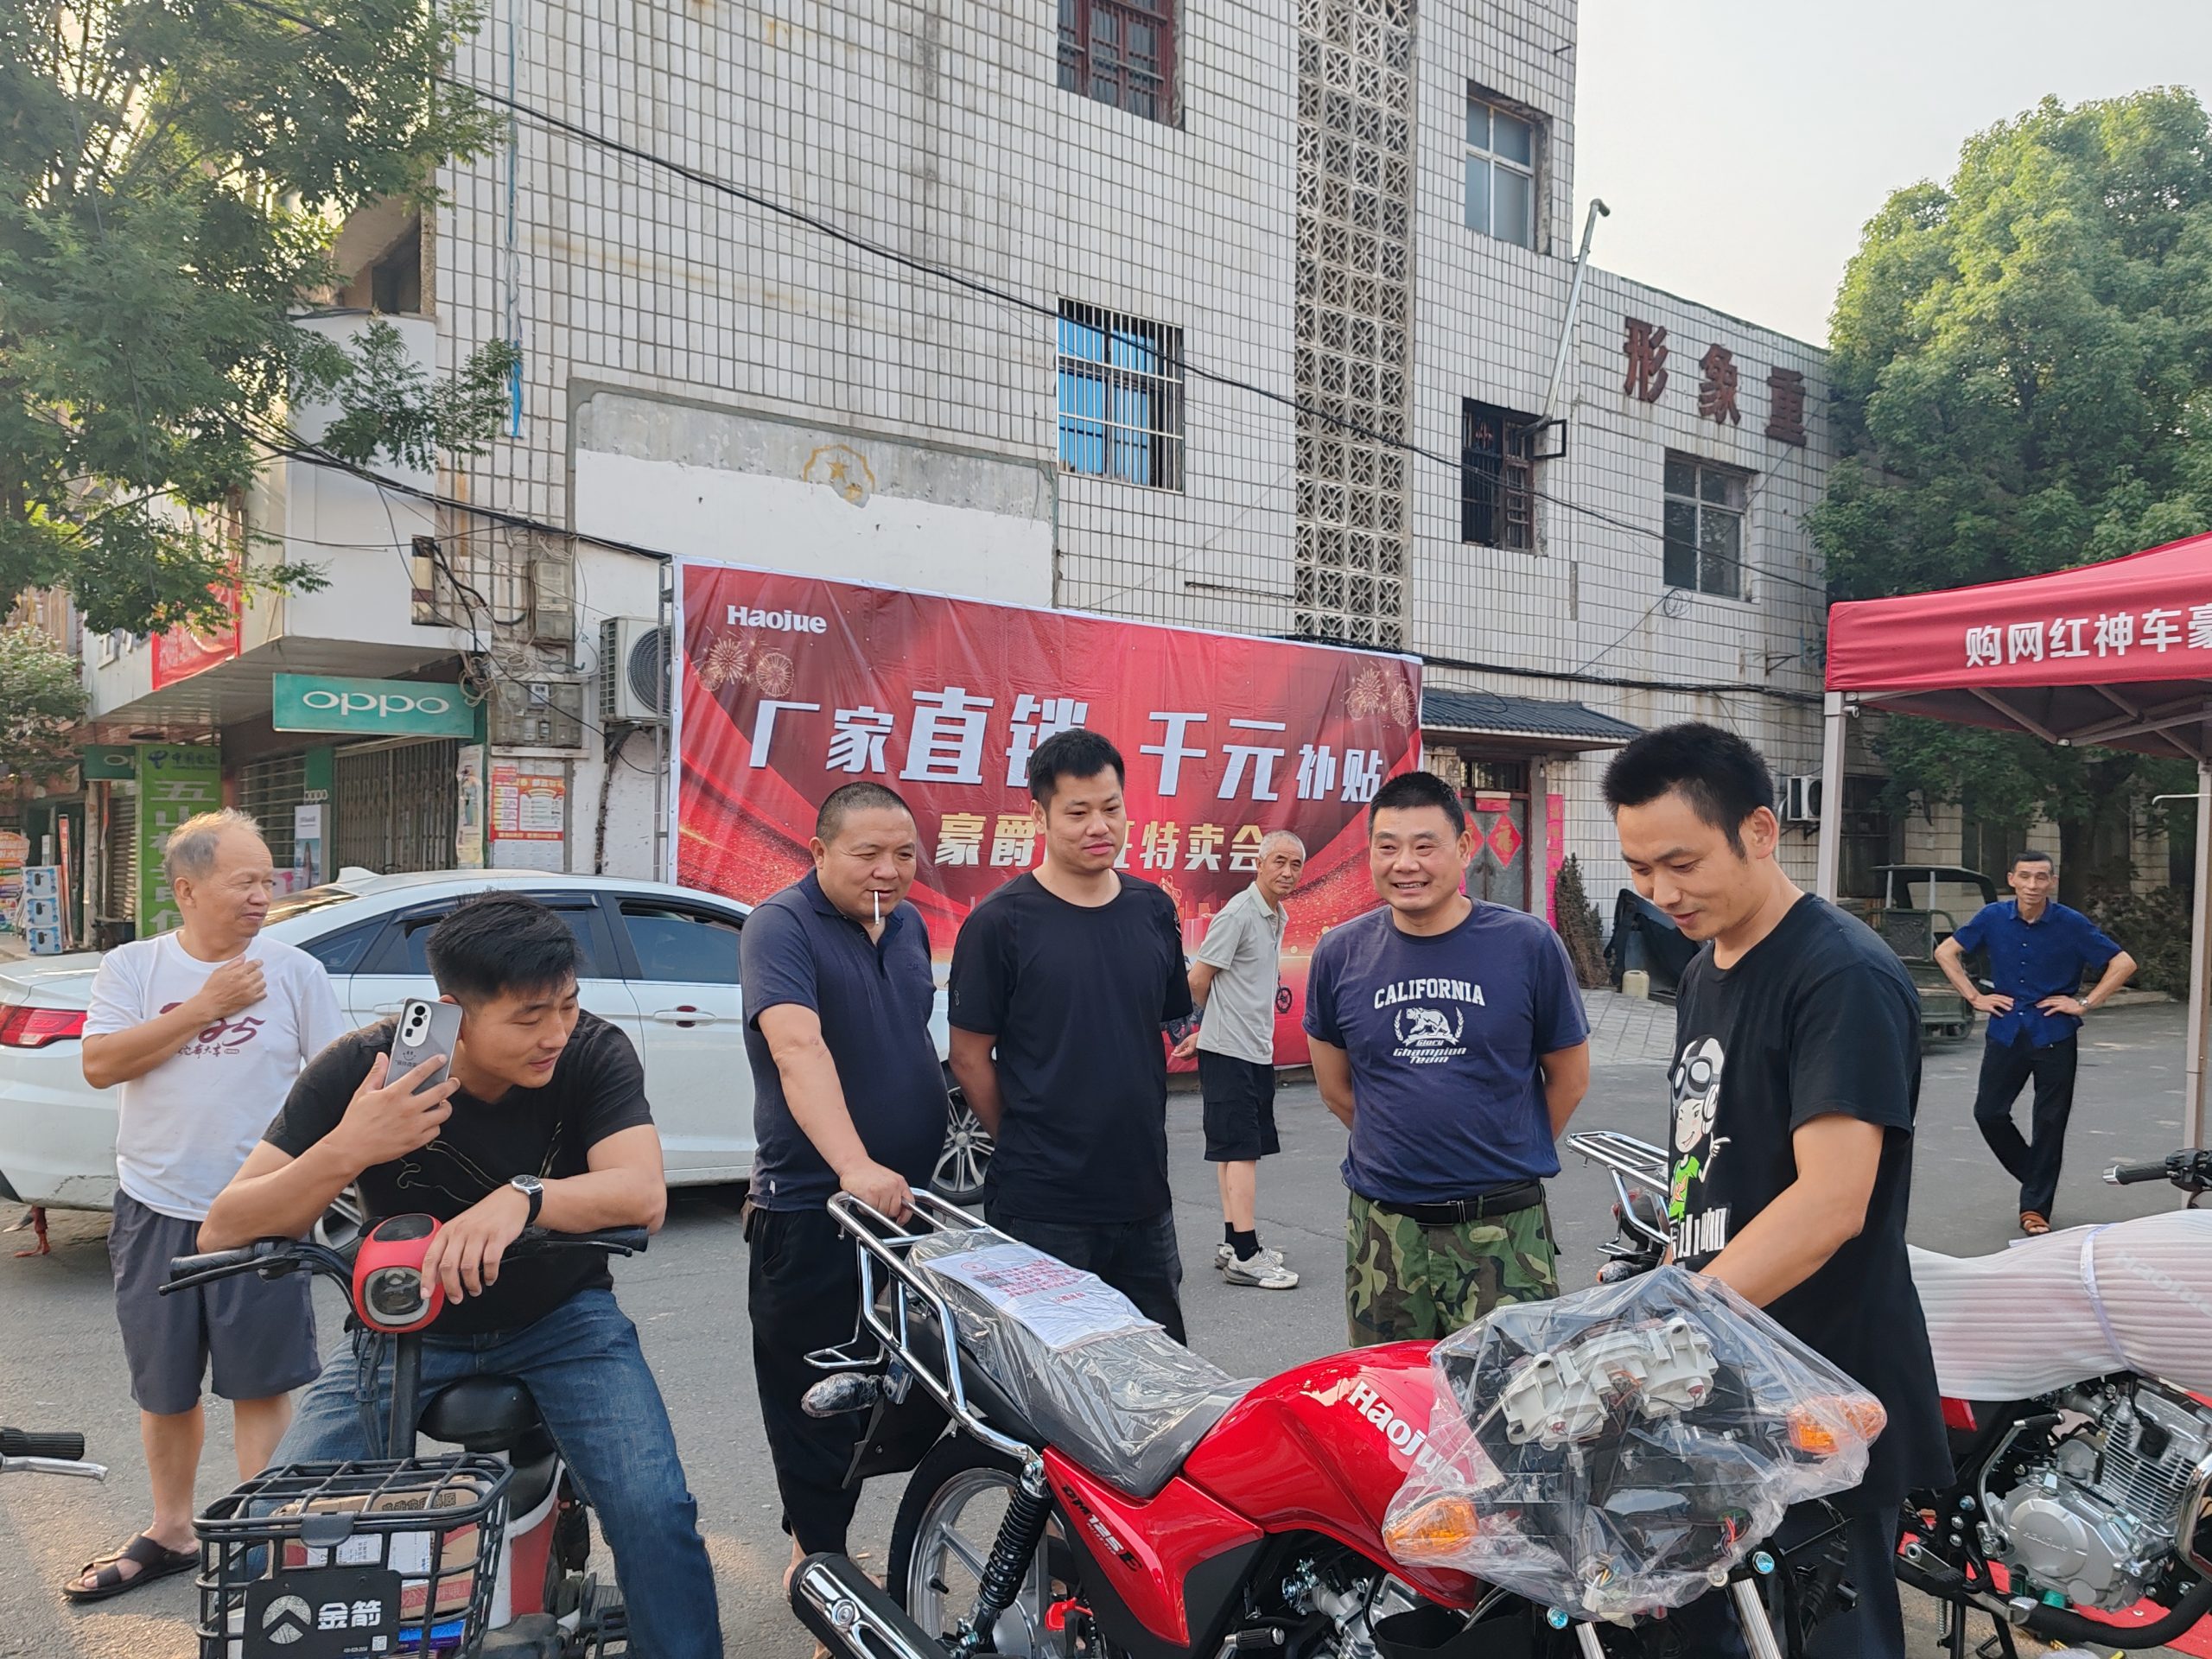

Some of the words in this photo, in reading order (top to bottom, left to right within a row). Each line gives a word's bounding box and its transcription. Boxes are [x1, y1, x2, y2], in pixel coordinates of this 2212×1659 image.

[727, 604, 827, 634] Haojue
[1139, 711, 1382, 803] 千元补贴
[1374, 978, 1485, 1009] CALIFORNIA
[317, 1599, 382, 1630] 金箭
